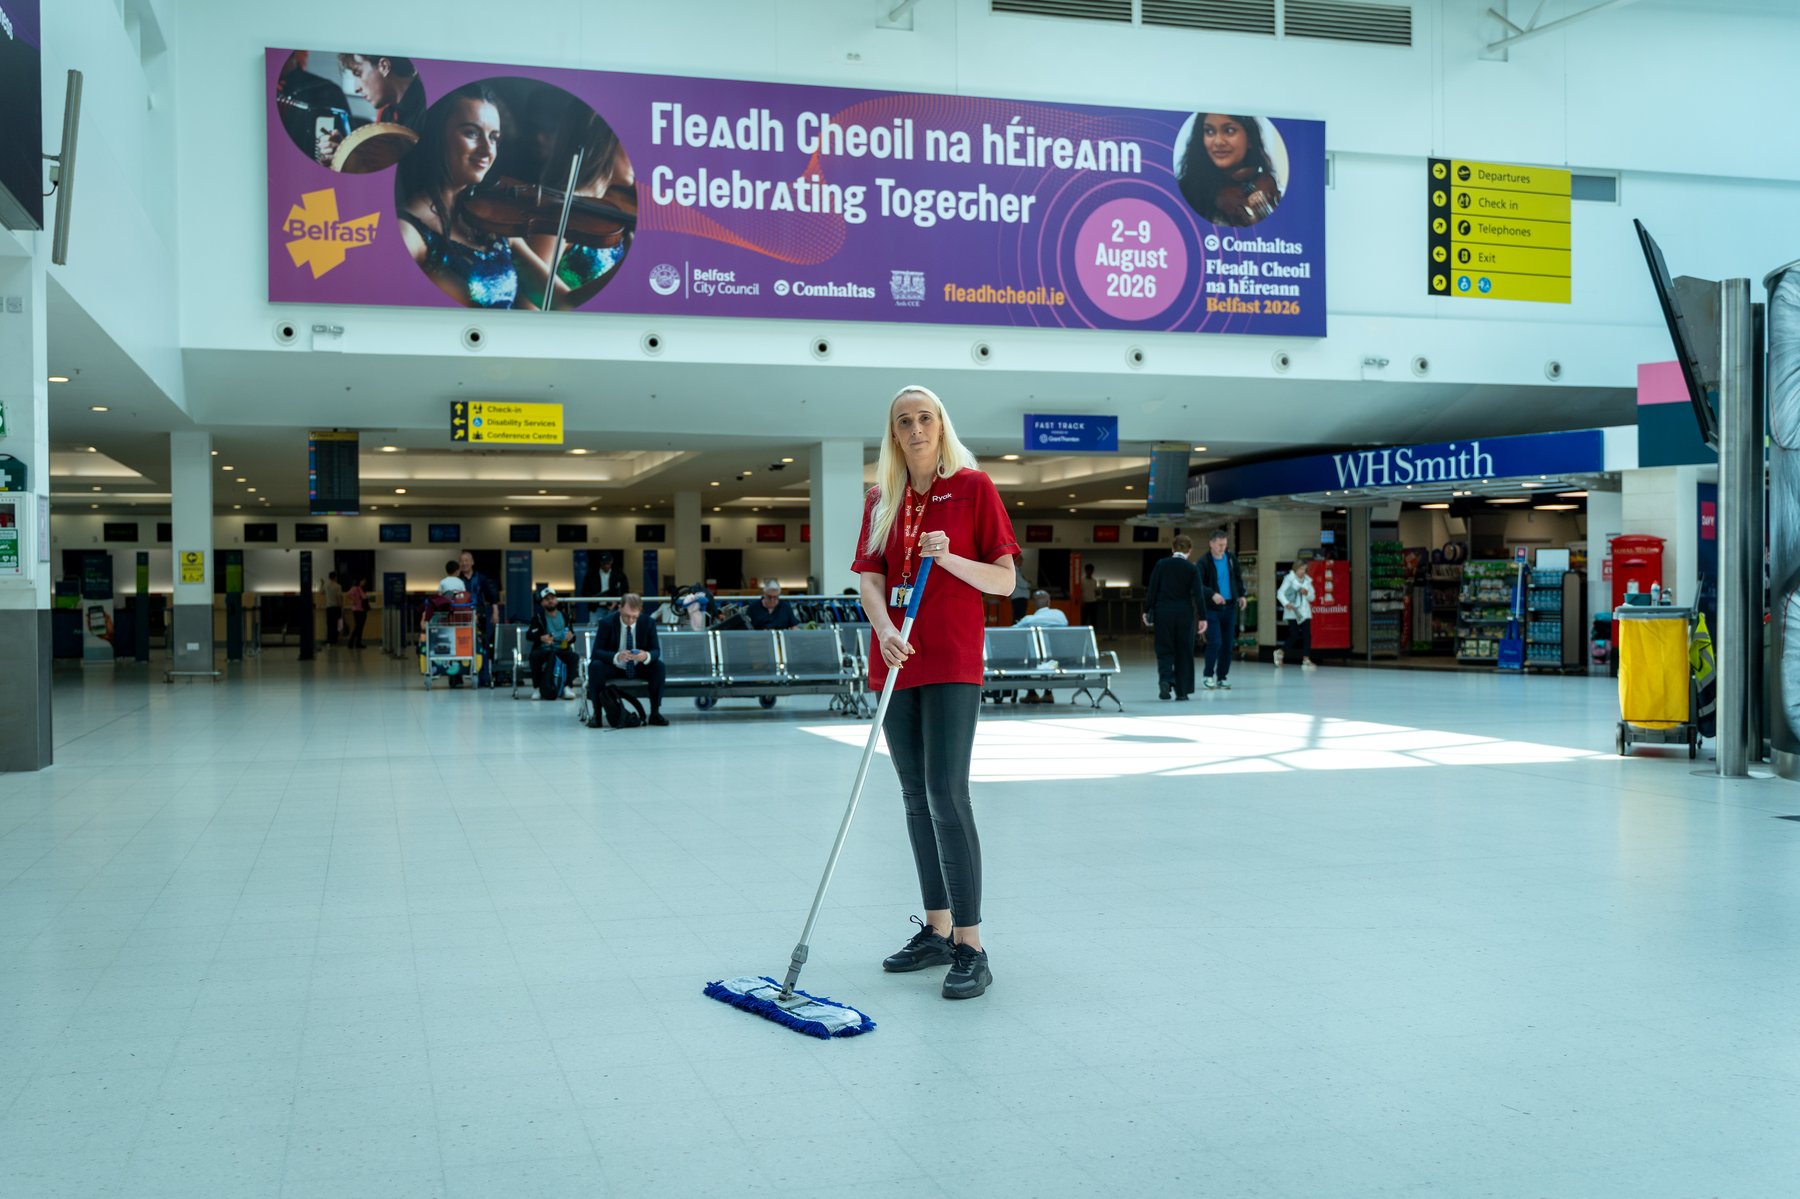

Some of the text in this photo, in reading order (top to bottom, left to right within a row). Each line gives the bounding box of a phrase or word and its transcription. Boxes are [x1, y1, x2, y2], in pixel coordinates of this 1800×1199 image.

[652, 101, 1142, 173] Fleadh Cheoil na hÉireann
[1478, 169, 1530, 184] Departures
[652, 165, 1036, 227] Celebrating Together
[1478, 197, 1518, 210] Check in
[289, 218, 376, 242] Belfast
[1478, 223, 1531, 237] Telephones
[1222, 236, 1303, 254] Comhaltas
[1095, 243, 1168, 272] August
[1478, 252, 1496, 264] Exit
[693, 268, 736, 282] Belfast
[1206, 259, 1311, 279] Fleadh Cheoil
[693, 281, 760, 297] City Council
[792, 281, 876, 299] Comhaltas
[944, 283, 1065, 306] fleadhcheoil.ie
[1106, 274, 1157, 298] 2026
[1206, 277, 1300, 297] na hÉireann
[1206, 297, 1300, 315] Belfast 2026
[487, 405, 522, 414] Check-in
[487, 418, 556, 428] Disability Services
[1034, 421, 1085, 430] FAST TRACK
[487, 432, 558, 440] Conference Centre
[1332, 441, 1496, 488] WHSmith
[1185, 474, 1210, 507] mith
[1311, 604, 1348, 614] conomist
